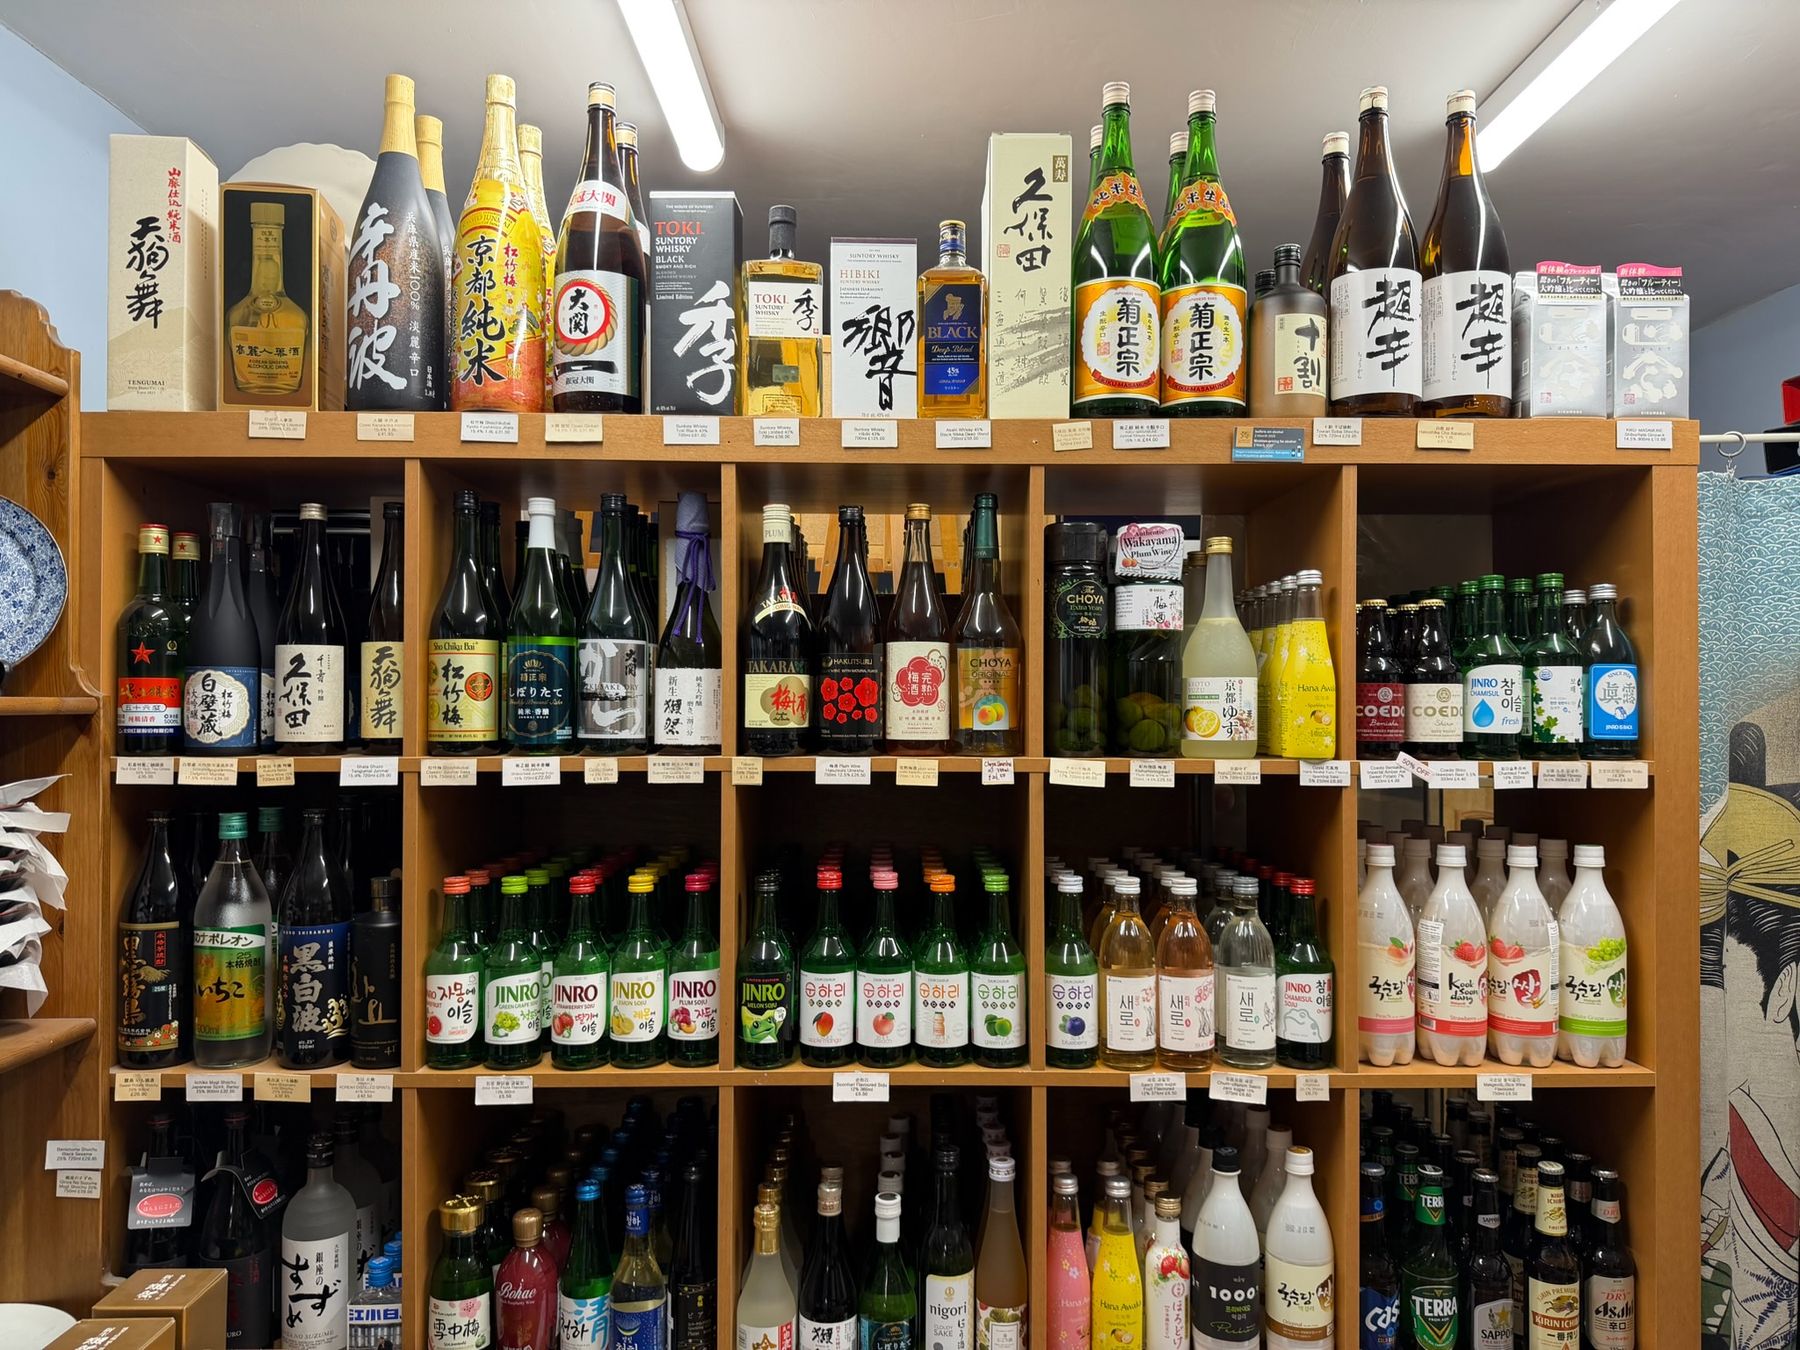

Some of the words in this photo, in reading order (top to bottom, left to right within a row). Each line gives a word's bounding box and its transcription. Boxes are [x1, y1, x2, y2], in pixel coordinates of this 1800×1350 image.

[654, 221, 703, 236] TOKI
[1003, 166, 1054, 273] 久保田
[655, 236, 698, 245] SUNTORY
[655, 245, 692, 253] WHISKY
[503, 242, 519, 288] 松竹梅
[655, 255, 685, 264] BLACK
[126, 216, 170, 329] 天狗舞
[839, 269, 880, 279] HIBIKI
[754, 293, 786, 304] TOKI
[459, 235, 507, 386] 京都純米
[568, 287, 590, 336] 大関
[927, 326, 978, 339] BLACK
[1116, 297, 1142, 377] 菊正宗
[1361, 274, 1417, 387] 超辛
[1455, 276, 1508, 389] 超辛
[931, 344, 951, 355] Deep
[951, 344, 975, 353] Blend
[1189, 302, 1215, 380] 菊正宗
[1293, 317, 1321, 389] 十割
[763, 528, 785, 539] PLUM
[1134, 528, 1166, 538] Authentic
[1123, 535, 1178, 551] Wakayama
[1130, 549, 1152, 559] Plum
[1152, 547, 1174, 558] Wine
[1066, 594, 1105, 604] CHOYA
[433, 642, 444, 651] Sho
[444, 642, 463, 652] Chiku
[748, 659, 796, 673] TAKARA
[833, 658, 873, 666] HAKUTSURU
[969, 658, 1012, 668] CHOYA
[907, 671, 919, 696] 梅酒
[971, 670, 1010, 679] ORIGINAL
[1471, 677, 1498, 690] JINRO
[278, 652, 312, 729] 久保田
[369, 645, 402, 735] 天狗舞
[441, 658, 465, 728] 松竹梅
[508, 686, 564, 698] しぼりたて
[668, 675, 678, 697] 新生
[921, 672, 933, 696] 完熟
[1297, 684, 1319, 692] Hana
[1501, 677, 1516, 697] 참
[197, 673, 223, 737] 白壁蔵
[221, 688, 233, 719] 松竹梅
[770, 682, 807, 721] 梅酒
[1222, 679, 1239, 738] 京都ゆず
[1500, 697, 1522, 713] 이슬
[663, 698, 683, 736] 獺祭
[1501, 716, 1520, 726] fresh
[1401, 758, 1416, 770] 50%
[1415, 767, 1432, 778] OFF
[289, 941, 327, 1033] 黒白波
[671, 979, 717, 1001] JINRO
[804, 981, 846, 998] 순하리
[1285, 981, 1312, 994] JINRO
[1315, 979, 1327, 994] 참
[1368, 975, 1404, 1001] 국순당
[1448, 972, 1474, 990] Kook
[1513, 972, 1540, 1002] 쌀
[1565, 975, 1602, 1002] 국순당
[437, 981, 476, 1004] 자몽에
[494, 981, 541, 1008] JINRO
[553, 984, 599, 1005] JINRO
[612, 980, 656, 1001] JINRO
[741, 982, 786, 1004] JINRO
[863, 982, 904, 999] 순하리
[919, 982, 960, 999] 순하리
[977, 983, 1019, 1000] 순하리
[1052, 983, 1094, 1000] 순하리
[1284, 993, 1313, 1003] CHAMISUL
[1450, 991, 1474, 1005] dang
[1459, 988, 1479, 996] soon
[447, 1000, 474, 1025] 이슬
[747, 1001, 765, 1009] MELON
[1119, 994, 1134, 1027] 새로
[1170, 994, 1184, 1027] 새로
[1239, 991, 1254, 1023] 새로
[1284, 1000, 1298, 1008] SOJU
[581, 1021, 597, 1036] 이슬
[639, 1018, 656, 1033] 이슬
[700, 1017, 717, 1033] 이슬
[315, 1251, 324, 1286] 銀座の
[500, 1281, 537, 1300] Bohae
[1277, 1281, 1313, 1308] 국순당
[1605, 1292, 1628, 1301] DRY
[929, 1301, 967, 1320] nigori
[1099, 1299, 1120, 1311] Hana
[1411, 1295, 1458, 1317] TERRA
[1594, 1300, 1634, 1320] Asahi
[433, 1317, 481, 1341] 雪中梅
[1534, 1315, 1558, 1328] KIRIN
[1609, 1321, 1627, 1330] 辛口
[933, 1329, 953, 1337] SAKE
